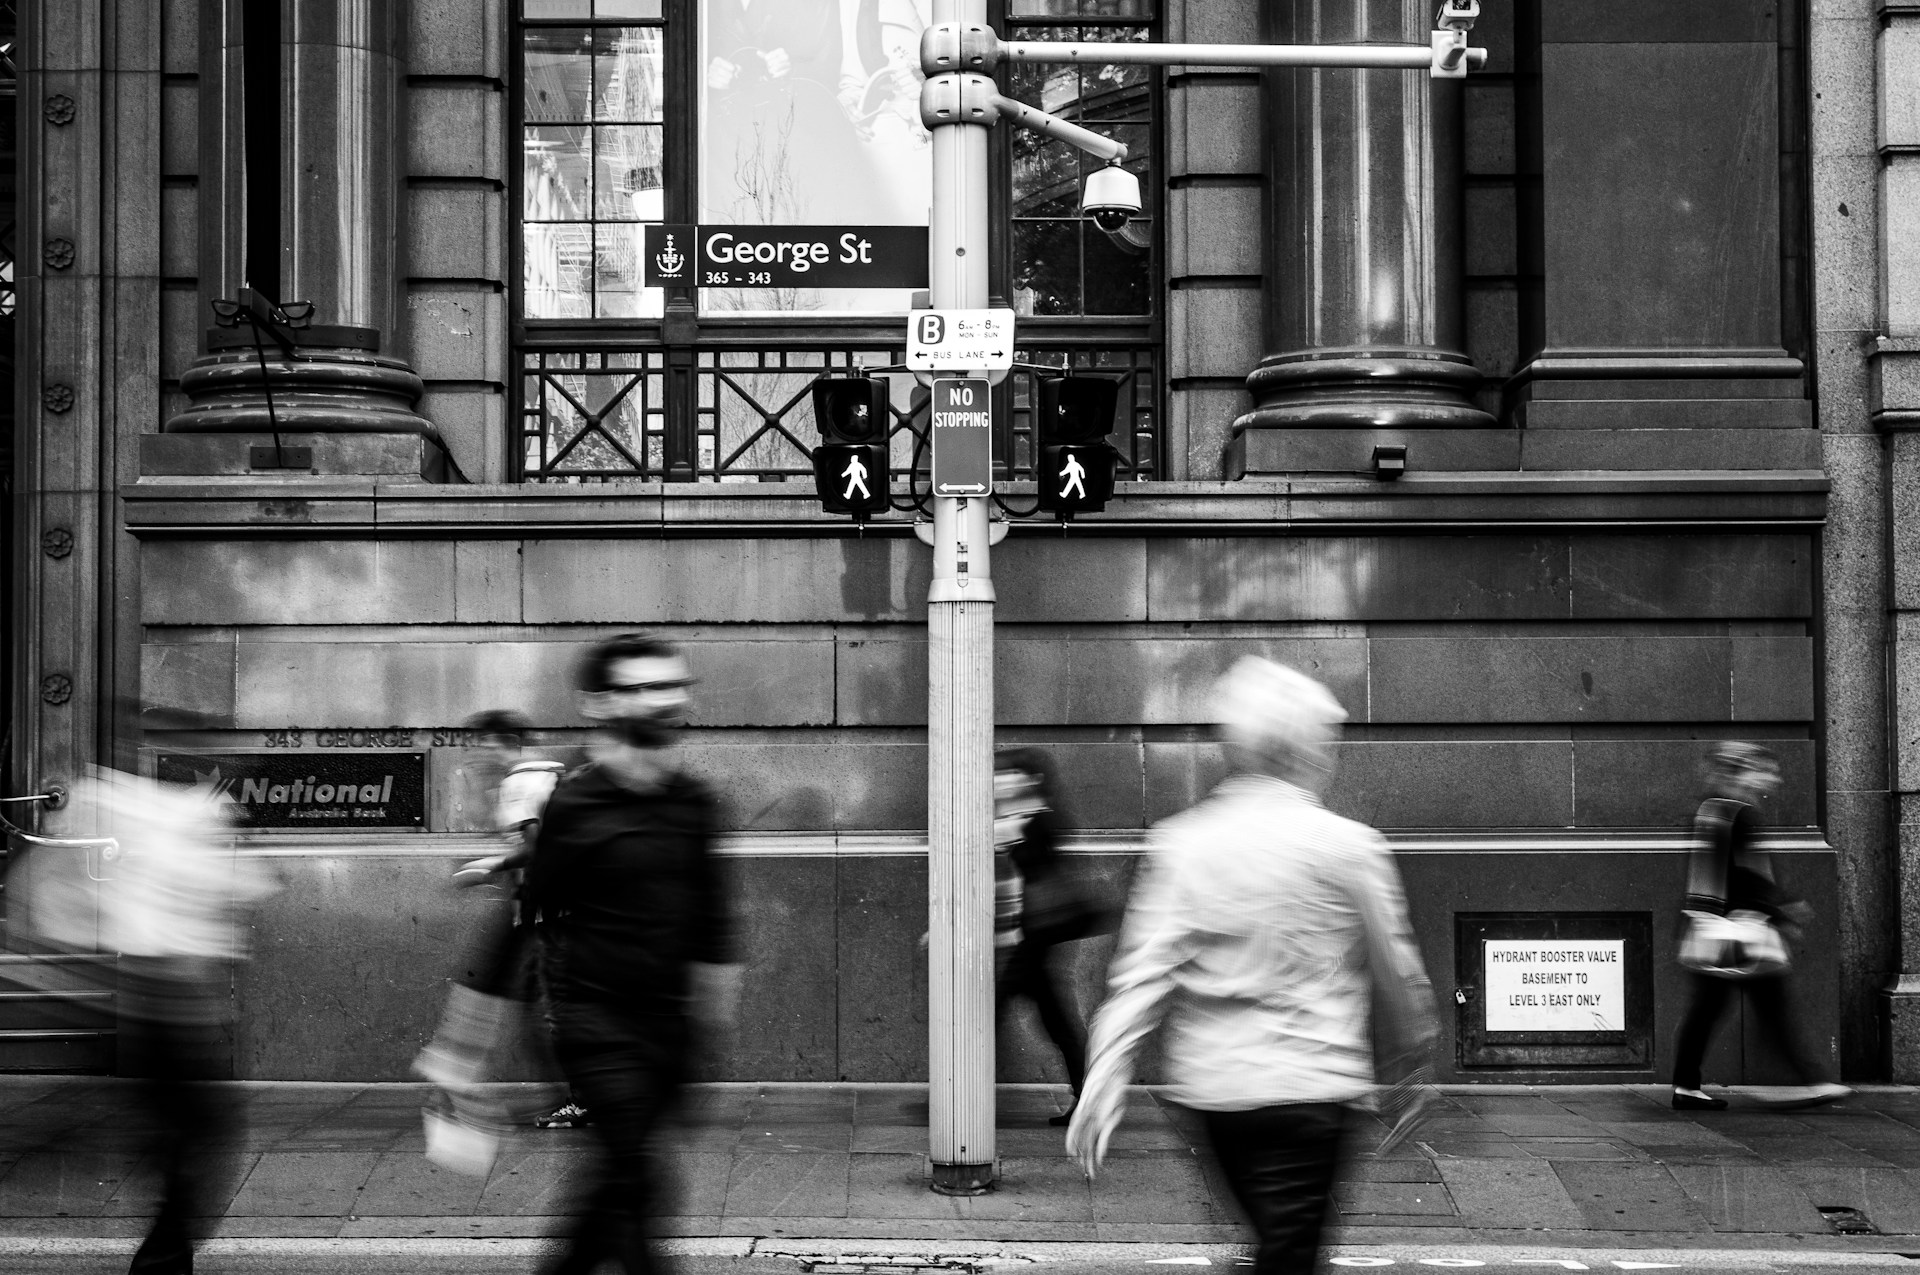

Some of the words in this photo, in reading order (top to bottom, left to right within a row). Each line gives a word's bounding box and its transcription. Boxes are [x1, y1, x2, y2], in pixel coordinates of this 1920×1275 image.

[705, 232, 830, 273] George
[839, 232, 873, 264] St
[705, 271, 729, 284] 365
[748, 271, 772, 284] 343
[923, 316, 941, 344] B
[933, 351, 952, 360] BUS
[958, 350, 985, 359] LANE
[949, 387, 974, 407] NO
[934, 411, 989, 428] STOPPING
[316, 729, 414, 748] GEORGE
[239, 774, 394, 804] National
[288, 807, 349, 819] Australia
[353, 806, 387, 819] Bank
[1492, 951, 1538, 963] HYDRANT
[1540, 951, 1585, 963] BOOSTER
[1587, 951, 1617, 963] VALVE
[1522, 972, 1573, 985] BASEMENT
[1575, 972, 1588, 985] TO
[1509, 994, 1539, 1007] LEVEL
[1541, 994, 1547, 1007] 3
[1549, 994, 1574, 1007] EAST
[1576, 994, 1602, 1007] ONLY
